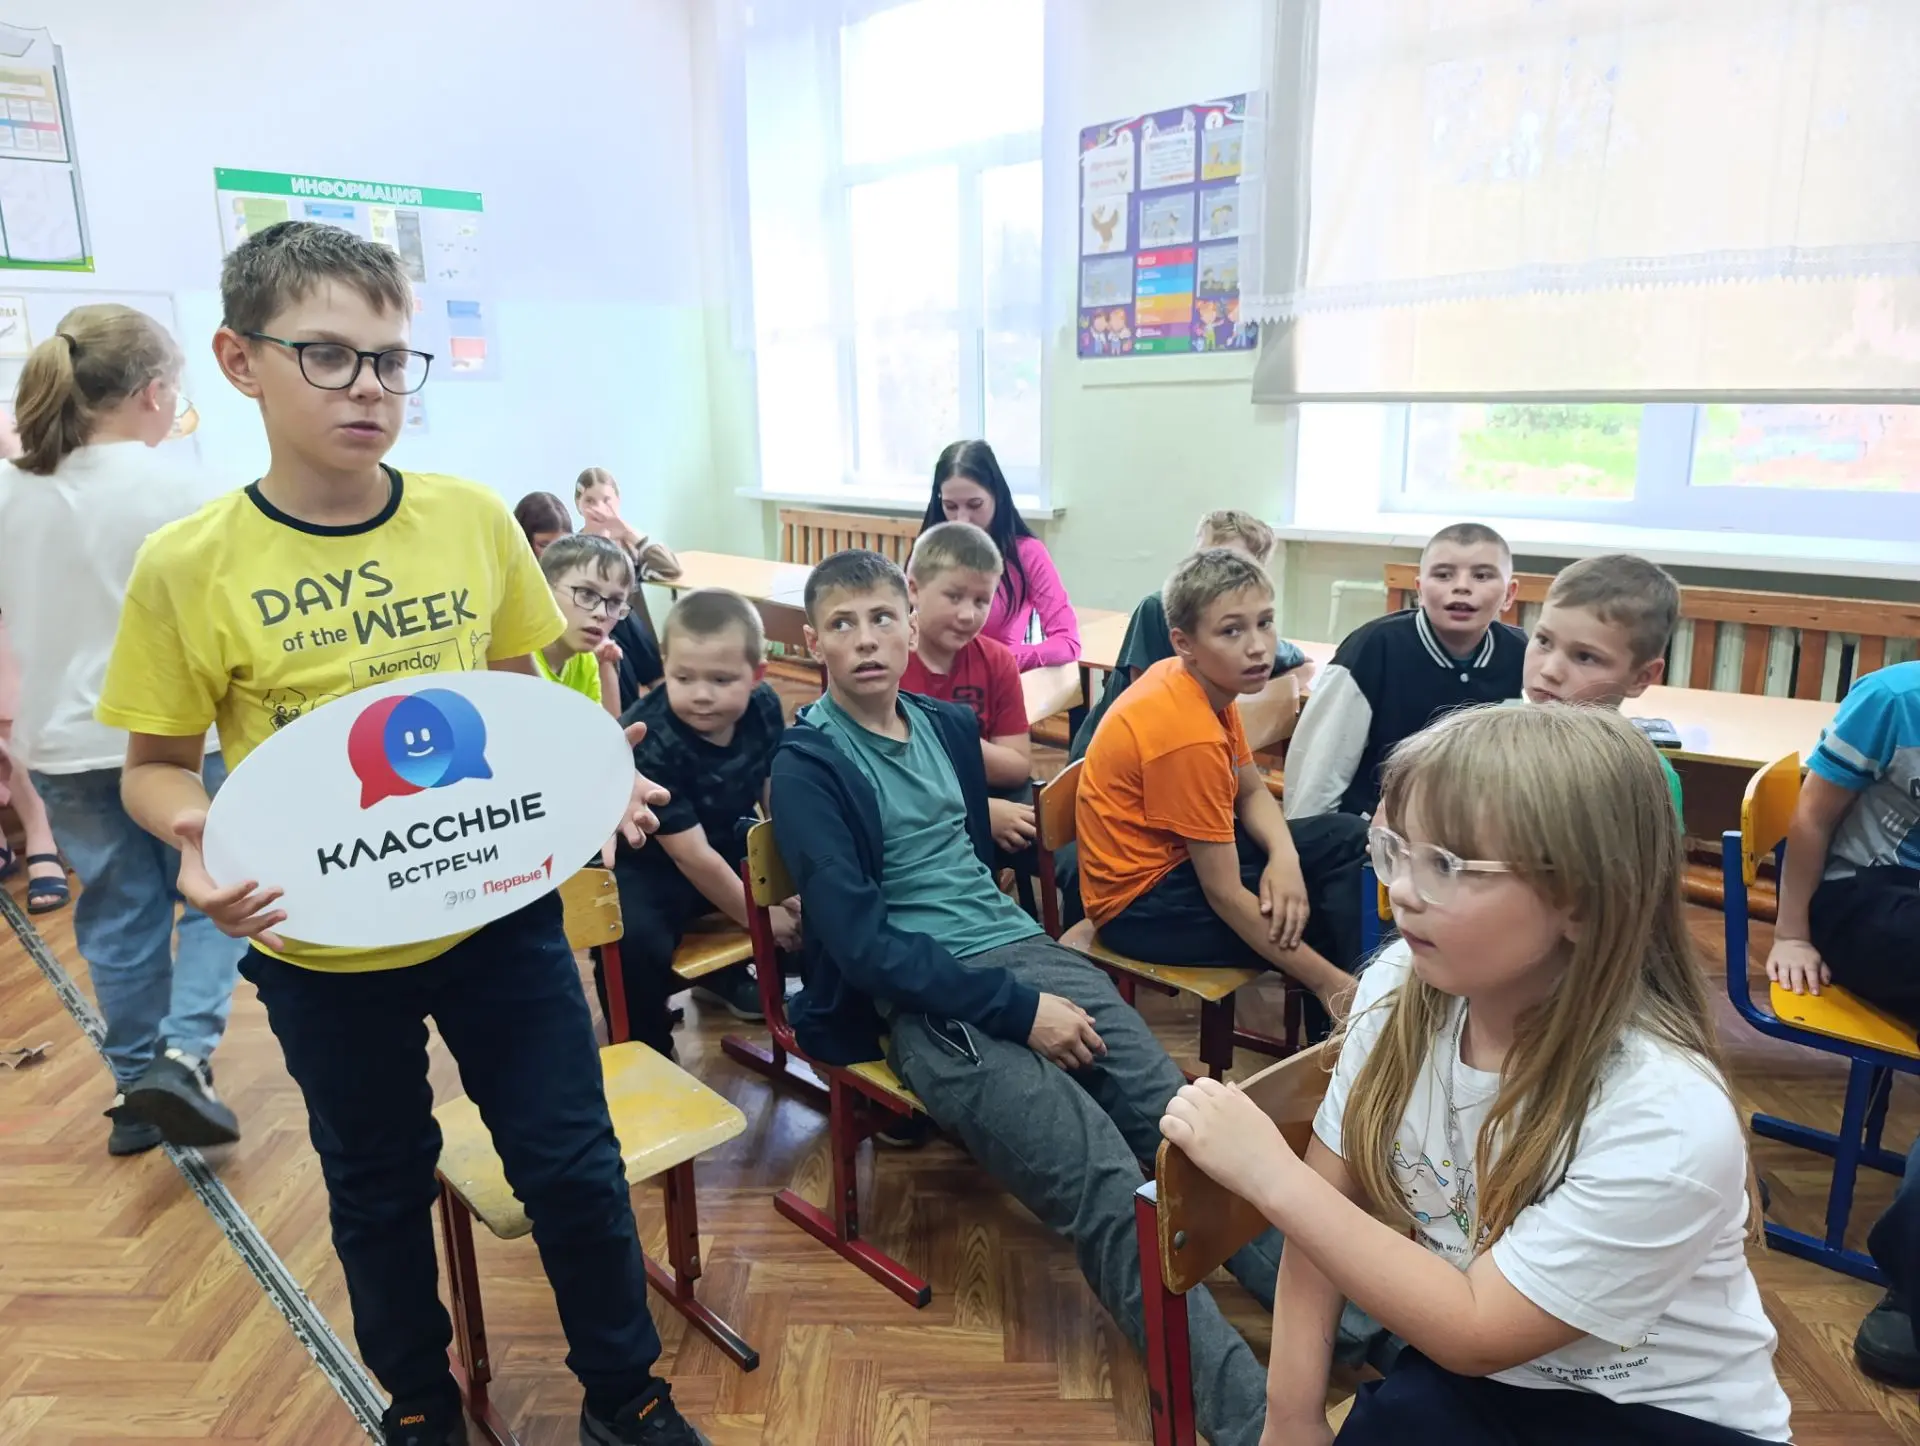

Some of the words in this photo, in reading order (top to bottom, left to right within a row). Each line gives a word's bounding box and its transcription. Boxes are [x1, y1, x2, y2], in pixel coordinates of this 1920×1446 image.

[291, 176, 423, 205] ИНФОРМАЦИЯ
[251, 560, 394, 627] DAYS
[282, 631, 305, 653] of
[309, 627, 348, 648] the
[352, 588, 478, 645] WEEK
[368, 650, 442, 679] Monday
[316, 791, 547, 876] КЛАССНЫЕ
[387, 843, 500, 891] ВСТРЕЧИ
[444, 888, 477, 909] Это
[482, 867, 543, 896] Первые
